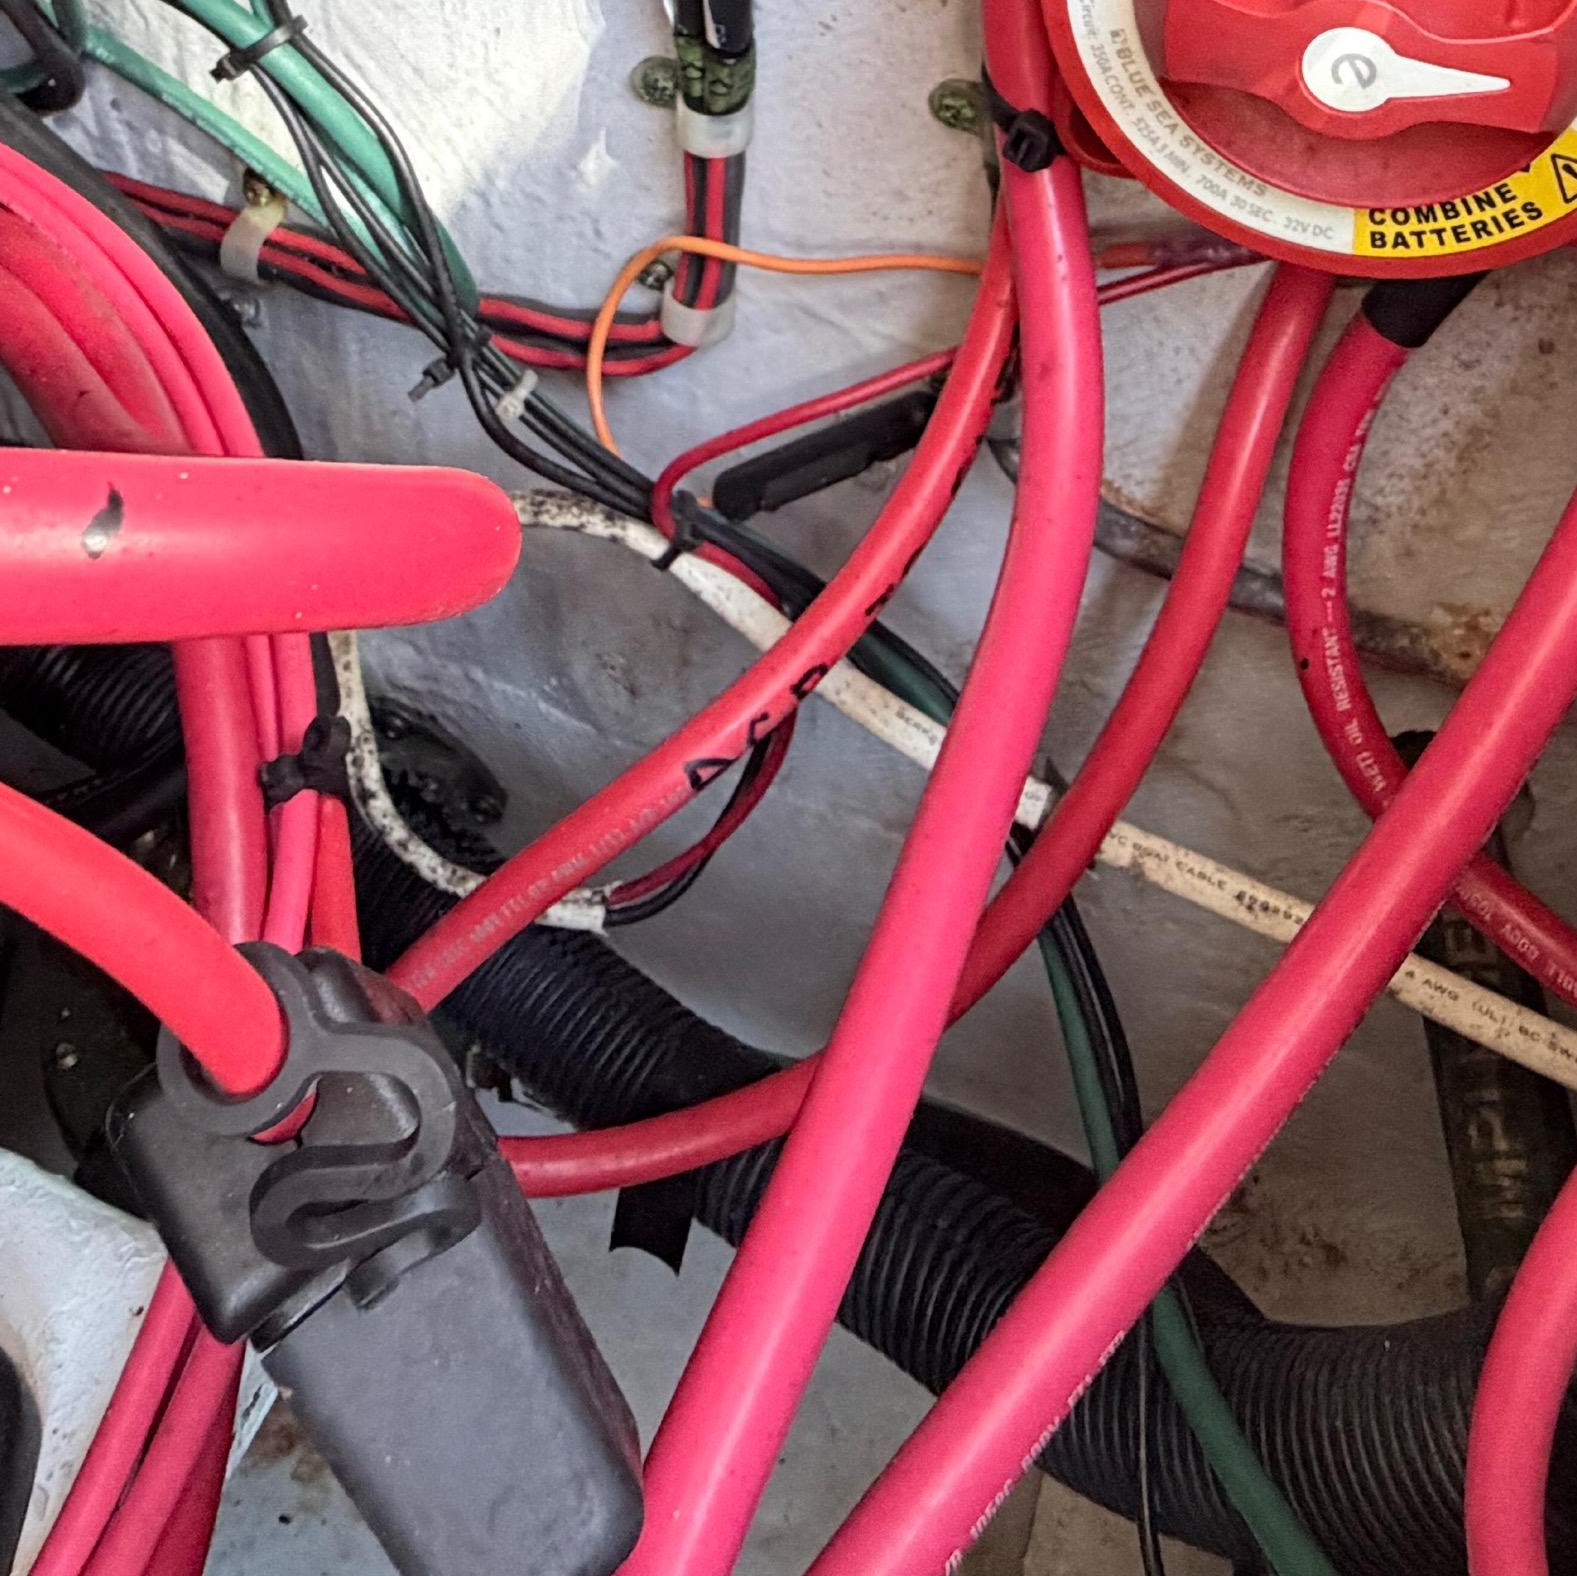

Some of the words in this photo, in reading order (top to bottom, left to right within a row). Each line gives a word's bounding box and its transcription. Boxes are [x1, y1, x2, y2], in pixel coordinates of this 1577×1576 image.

[1116, 46, 1155, 97] BLUE
[1146, 99, 1180, 134] SEA
[1179, 133, 1270, 197] SYSTEMS
[1368, 182, 1518, 226] COMBINE
[1369, 201, 1544, 250] BATTERIES
[1323, 627, 1352, 712] RESISTANT
